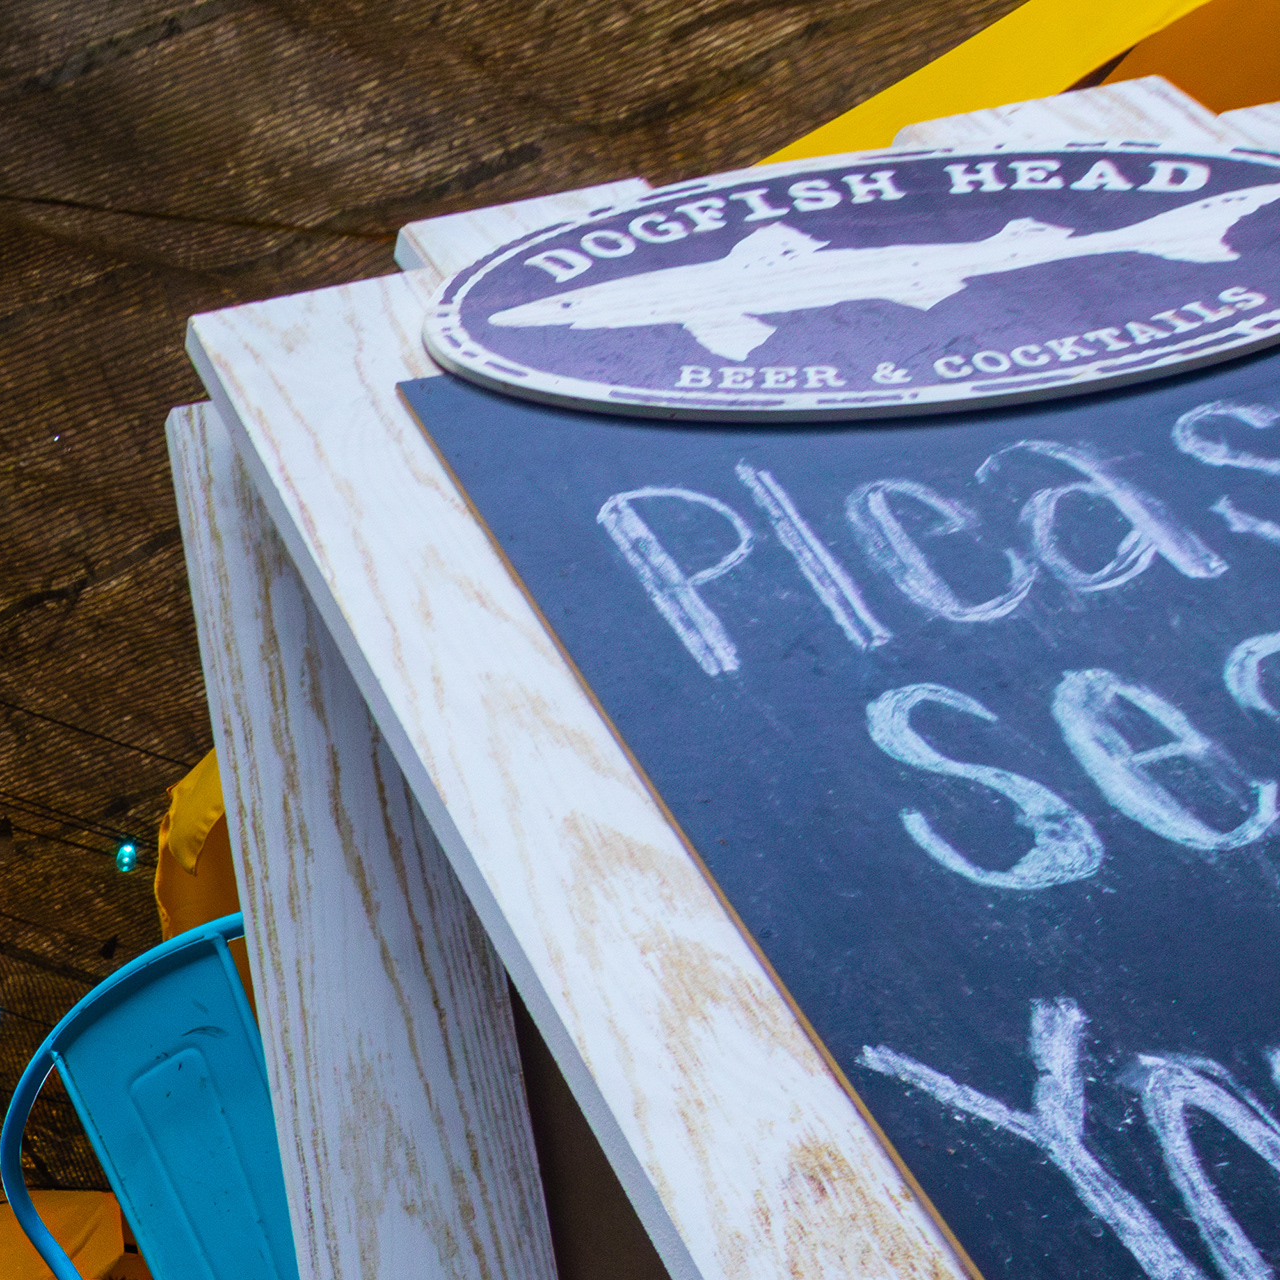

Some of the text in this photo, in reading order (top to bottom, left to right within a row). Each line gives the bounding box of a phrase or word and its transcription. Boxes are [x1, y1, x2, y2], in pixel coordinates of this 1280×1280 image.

[523, 158, 1212, 284] DOGFISH HEAD
[674, 285, 1268, 393] BEER & COCKTAILS
